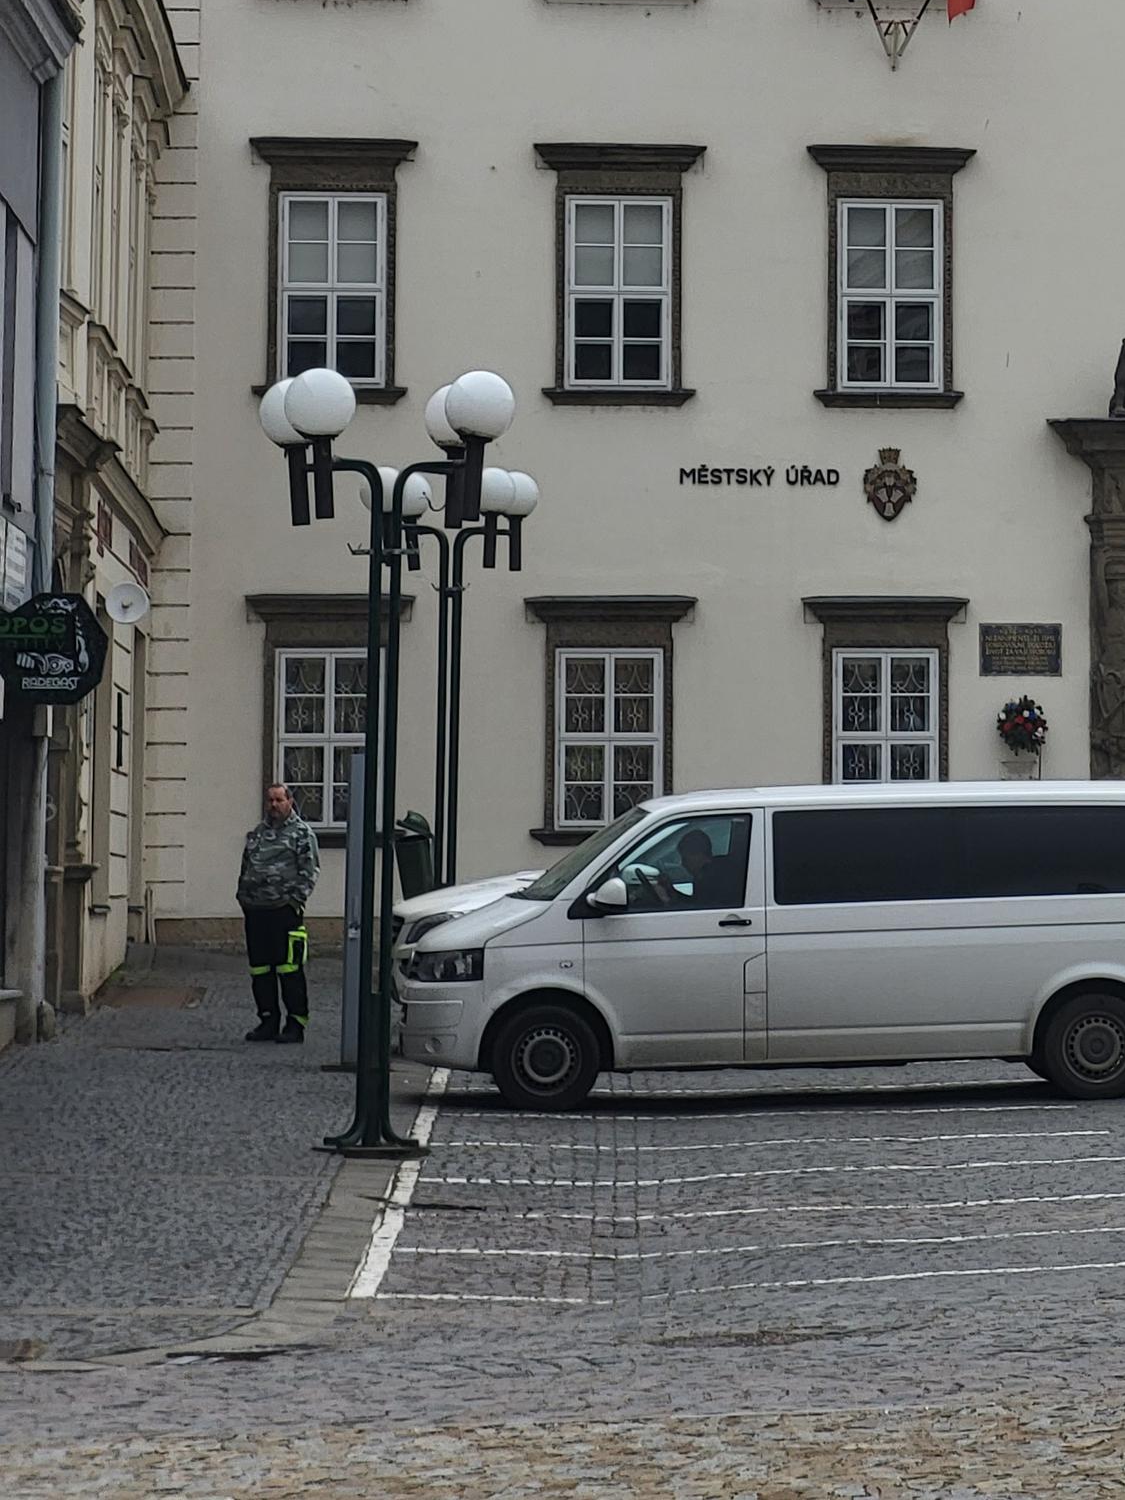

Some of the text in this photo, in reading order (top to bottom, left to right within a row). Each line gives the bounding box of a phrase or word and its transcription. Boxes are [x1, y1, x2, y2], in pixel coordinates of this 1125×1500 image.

[680, 464, 840, 486] MĚSTSKÝ ÚŘAD
[22, 677, 80, 690] RADEGAST
